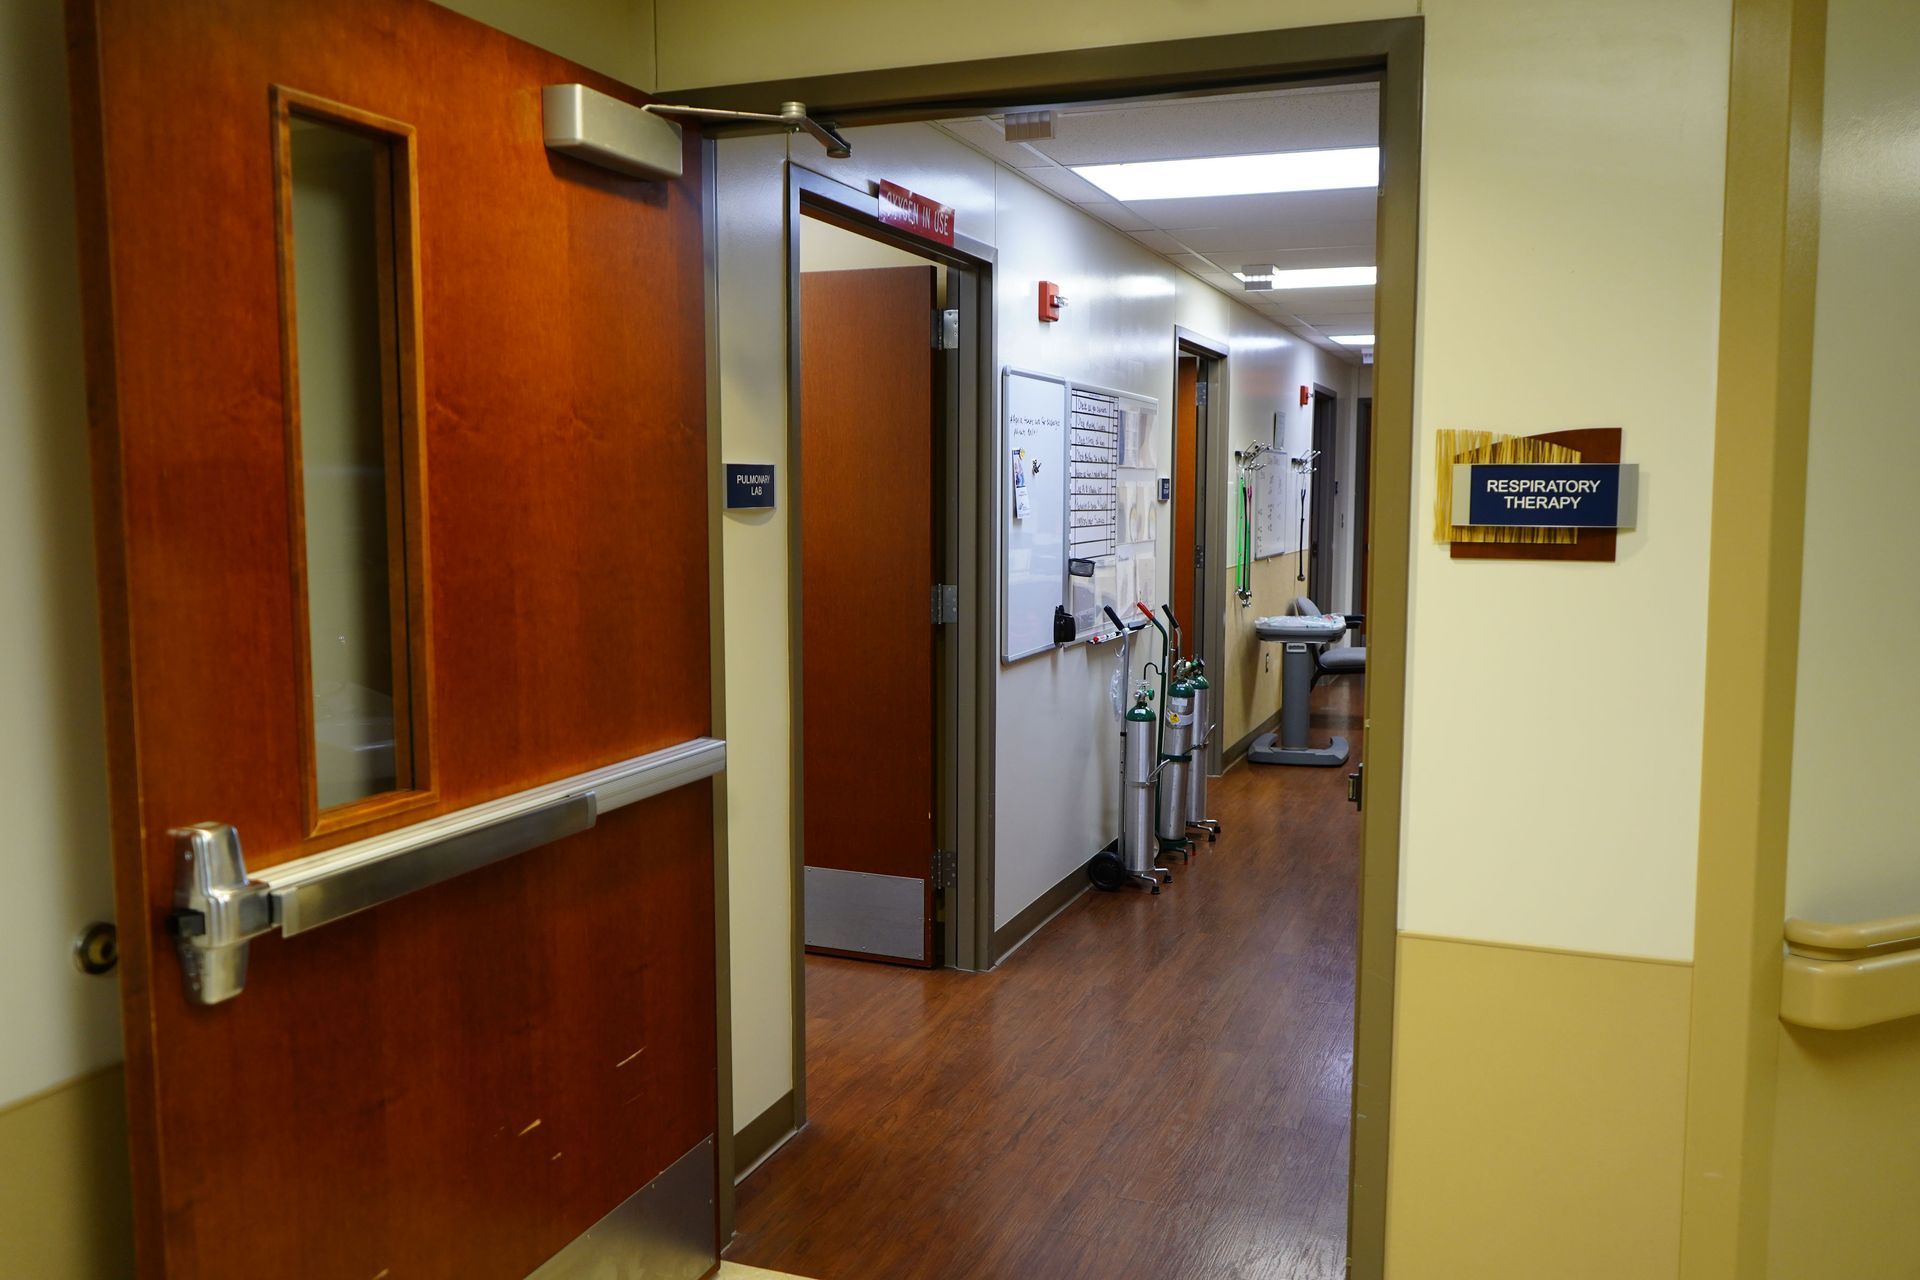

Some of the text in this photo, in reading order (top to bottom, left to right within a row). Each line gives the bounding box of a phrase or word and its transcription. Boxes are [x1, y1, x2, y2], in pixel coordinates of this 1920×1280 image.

[922, 205, 931, 230] IN
[933, 208, 949, 236] USE
[736, 474, 770, 484] PULMONARY
[1486, 479, 1601, 493] RESPIRATORY
[750, 486, 763, 496] LAB
[1503, 495, 1582, 509] THERAPY
